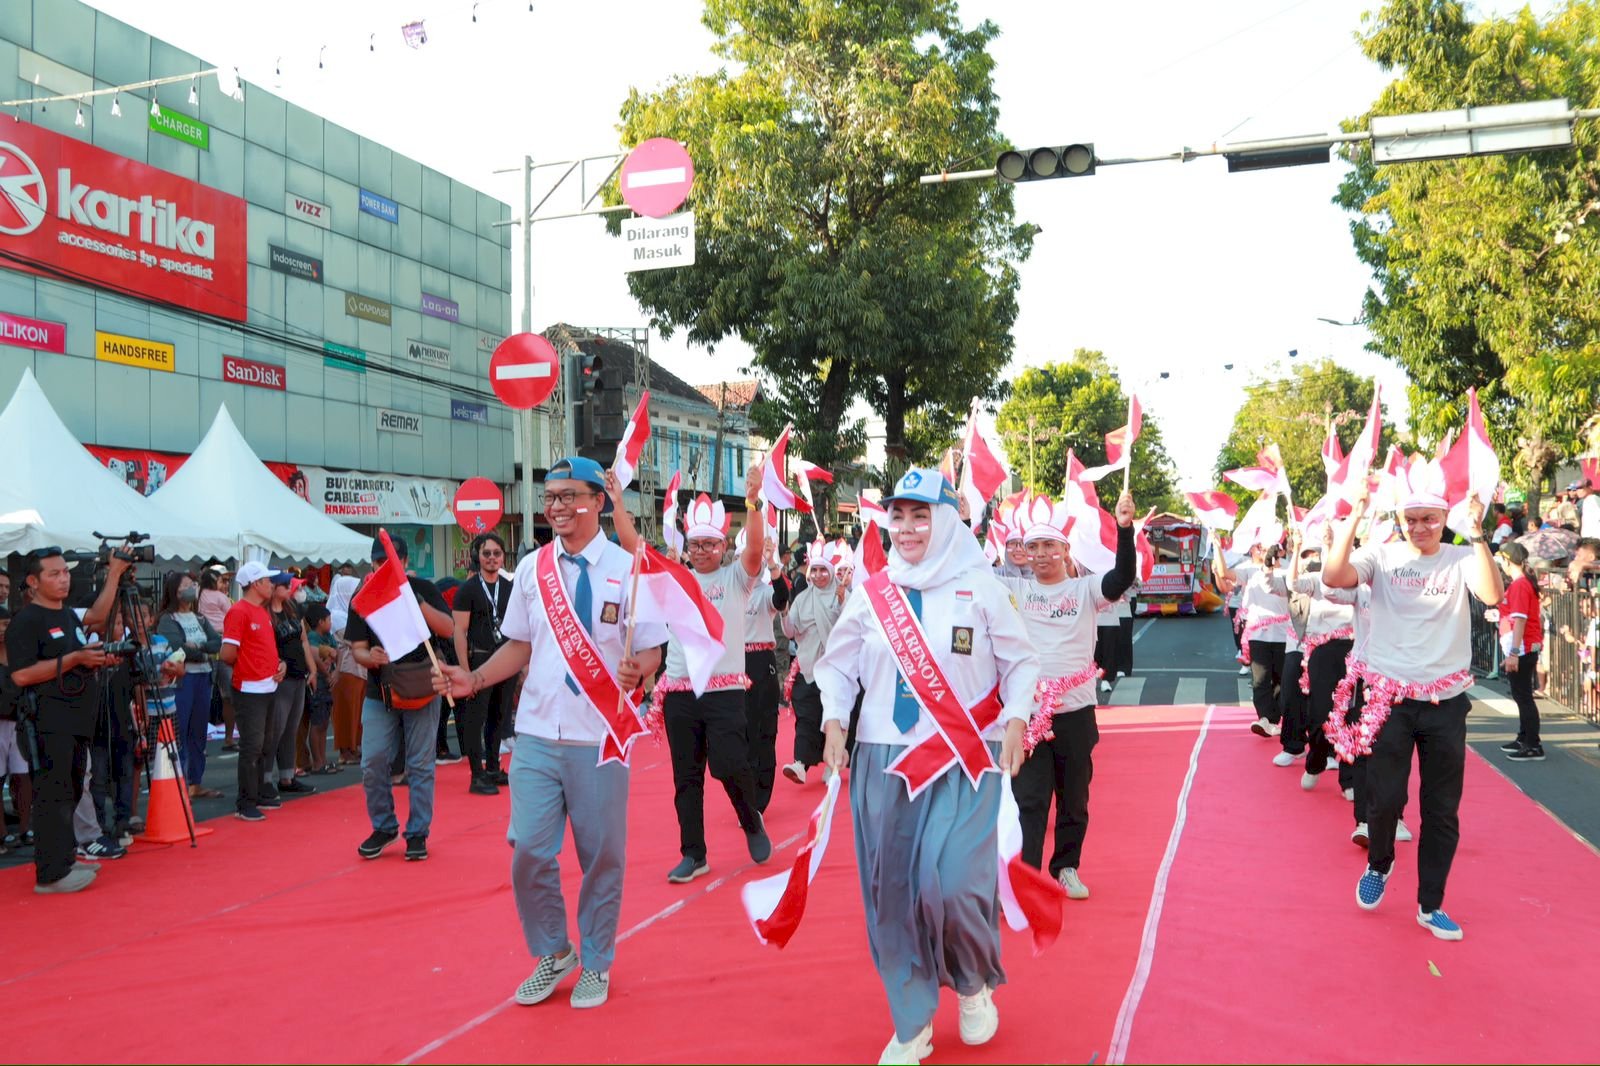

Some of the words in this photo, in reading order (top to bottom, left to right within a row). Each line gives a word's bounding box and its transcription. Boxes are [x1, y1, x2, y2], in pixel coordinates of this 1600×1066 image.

[155, 114, 202, 141] CHARGER
[57, 168, 215, 260] kartika
[361, 194, 381, 210] POWER
[381, 202, 395, 217] BANK
[627, 224, 689, 242] Dilarang
[58, 231, 137, 261] accessories
[160, 257, 213, 281] specialist
[633, 243, 682, 260] Masuk
[103, 341, 168, 363] HANDSFREE
[421, 346, 449, 361] MERCURY
[226, 361, 281, 386] SanDisk
[381, 412, 419, 432] REMAX
[325, 477, 347, 490] BUY
[324, 490, 360, 503] CABLE
[324, 503, 379, 516] HANDSFREE!
[1392, 567, 1421, 578] Klaten
[1050, 607, 1077, 618] 2045
[543, 571, 566, 614] JUARA
[561, 614, 601, 679] KRENOVA
[548, 603, 566, 639] TAHUN
[561, 638, 575, 658] 2024
[878, 584, 908, 626] JUARA
[901, 625, 945, 702] KRENOVA
[883, 615, 905, 654] TAHUN
[899, 652, 916, 676] 2024
